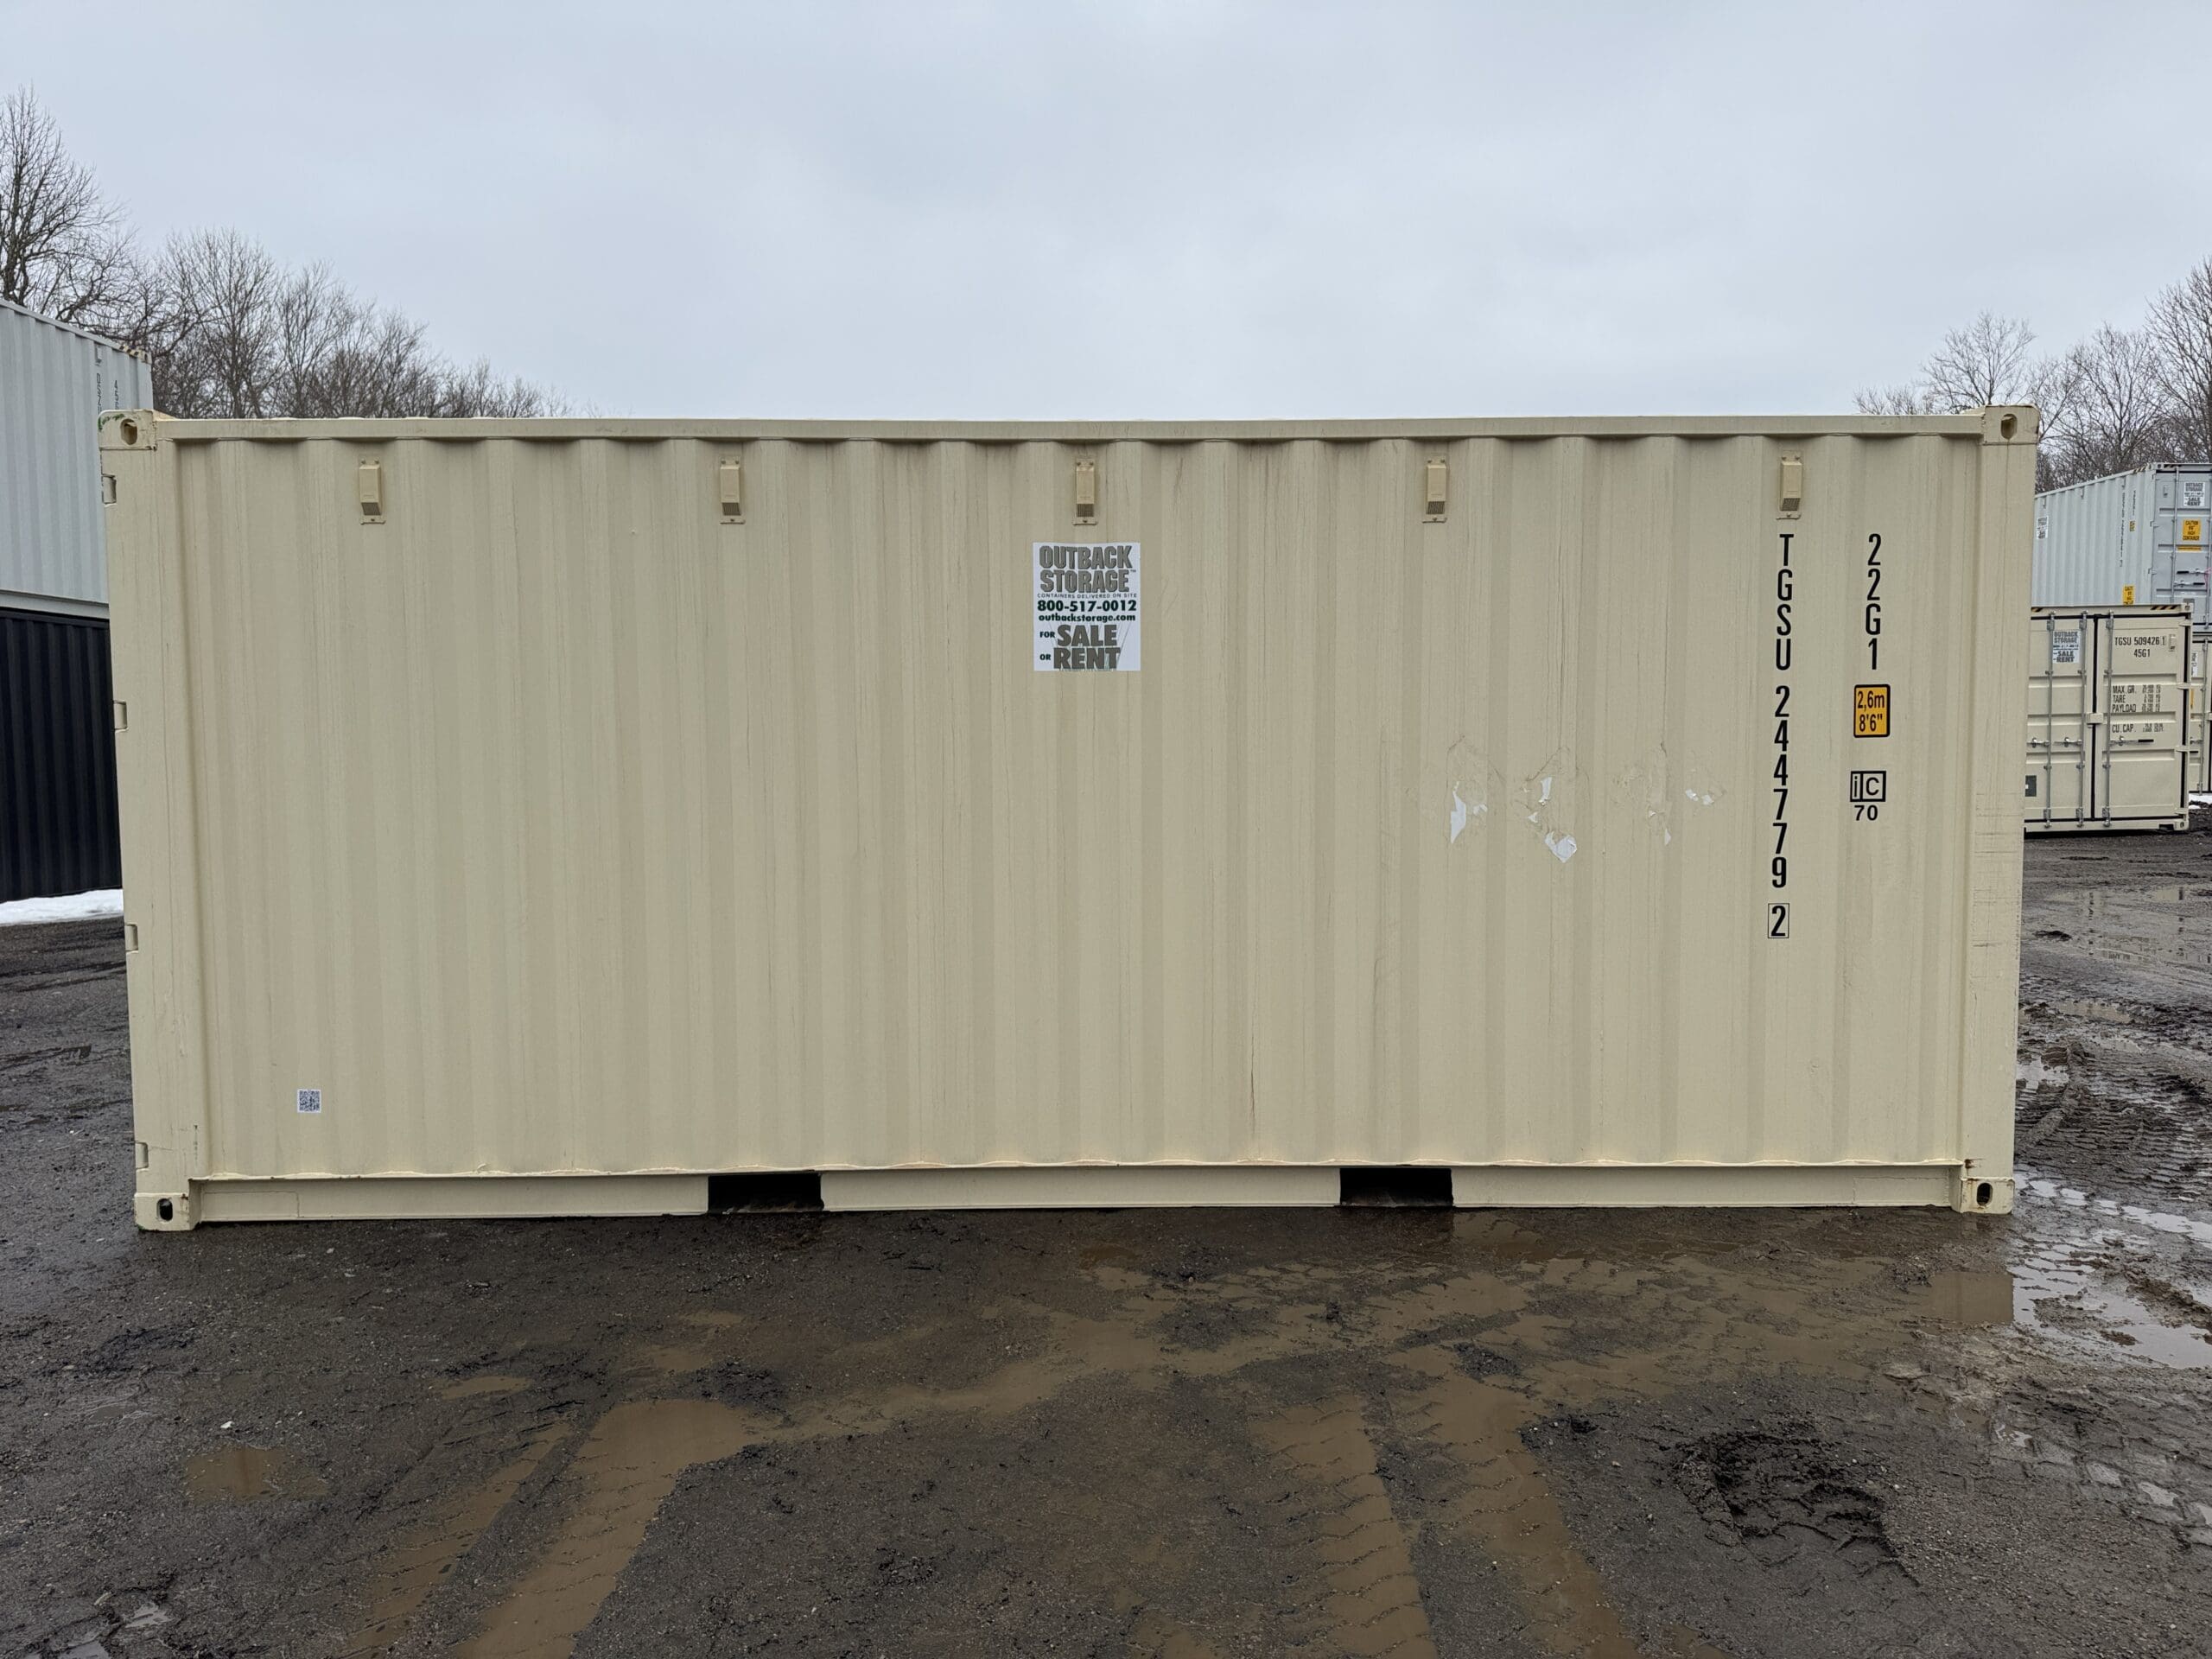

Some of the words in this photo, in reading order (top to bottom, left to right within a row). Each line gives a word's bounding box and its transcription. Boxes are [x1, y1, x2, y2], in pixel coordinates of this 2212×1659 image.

[1039, 545, 1133, 569] OUTBACK
[1040, 569, 1129, 593] STORAGE
[1037, 600, 1137, 612] 800-517-0012
[1776, 534, 1794, 671] TGSU
[1866, 533, 1882, 671] 22G1
[1039, 613, 1136, 623] outbackstorage.com
[1057, 625, 1117, 646] SALE
[2114, 637, 2132, 645] TGSU
[2133, 636, 2160, 645] 509426
[1053, 647, 1121, 670] RENT
[2133, 649, 2151, 658] 45G1
[1857, 690, 1885, 712] 2,6m
[2112, 704, 2136, 713] PAYLOAD
[2113, 695, 2126, 703] TARE
[1859, 713, 1883, 732] 8'6"
[1772, 685, 1790, 888] 244779
[1854, 804, 1878, 821] 70
[1770, 905, 1786, 937] 2
